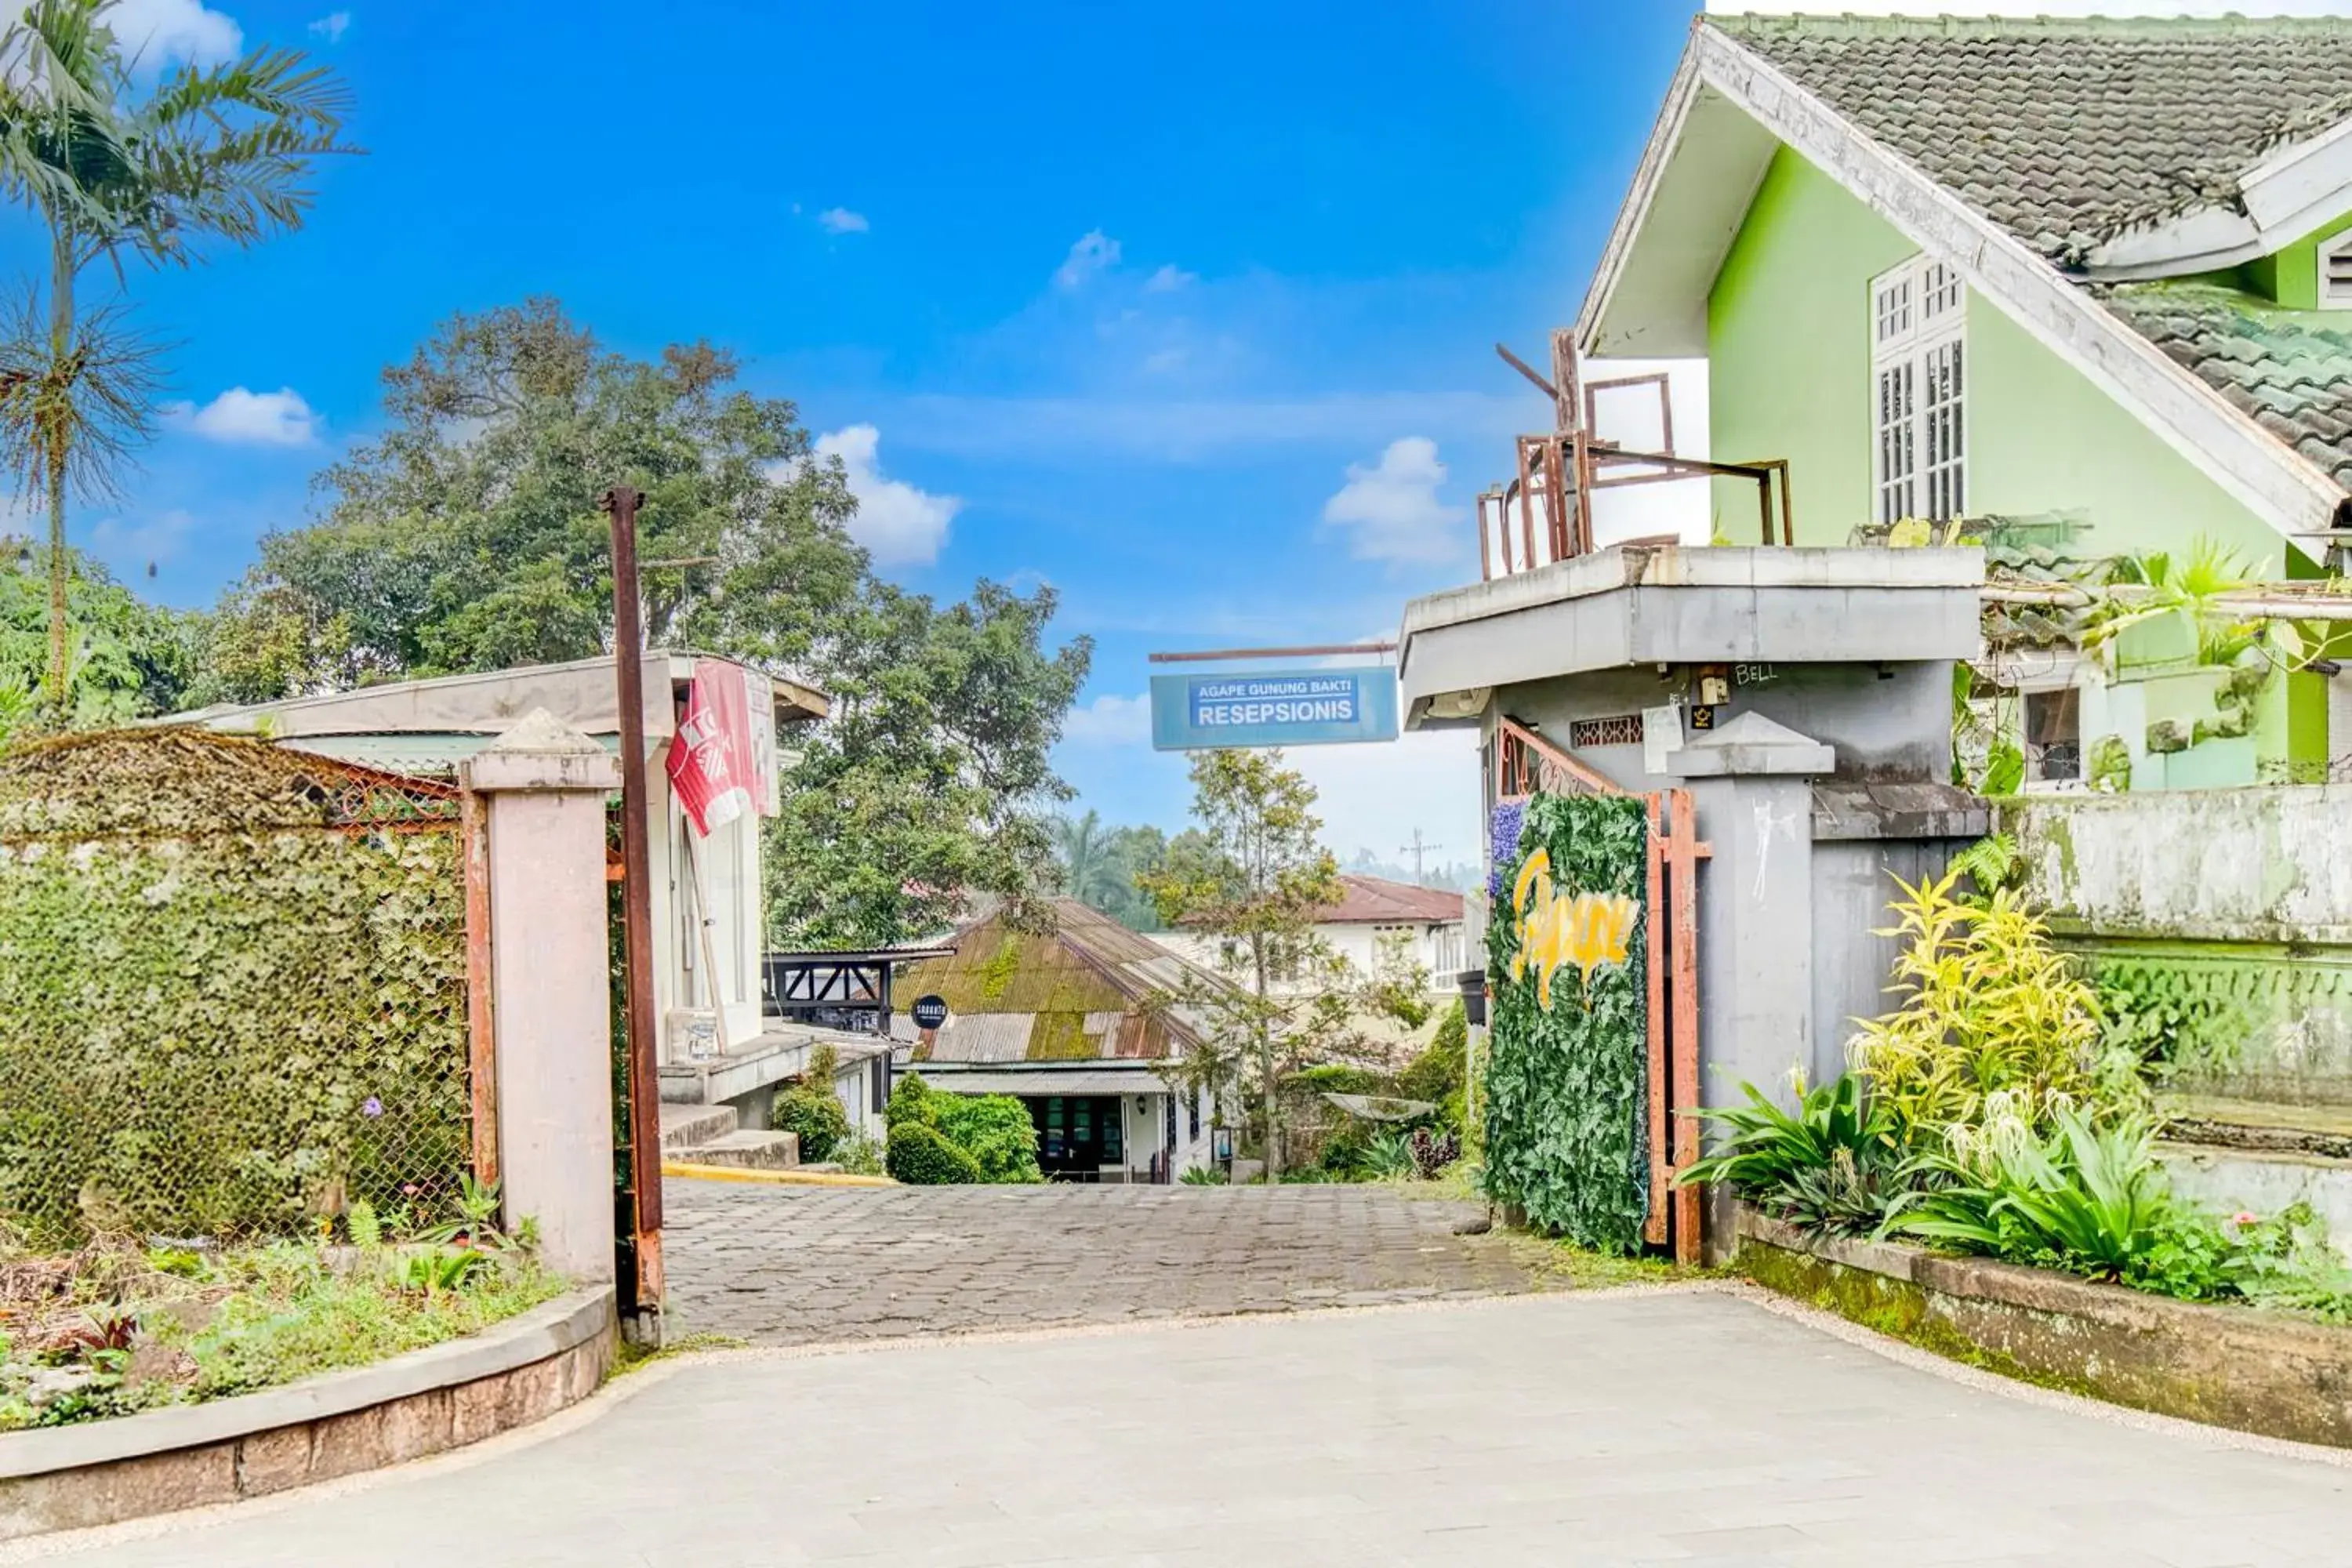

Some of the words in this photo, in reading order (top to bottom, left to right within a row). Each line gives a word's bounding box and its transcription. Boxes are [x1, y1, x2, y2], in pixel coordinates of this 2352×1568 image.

[1735, 664, 1778, 685] BELL
[1199, 684, 1246, 698] AGAPE
[1248, 681, 1308, 695] GUNUNG
[1311, 679, 1351, 693] BAKTI
[1199, 700, 1353, 725] RESEPSIONIS
